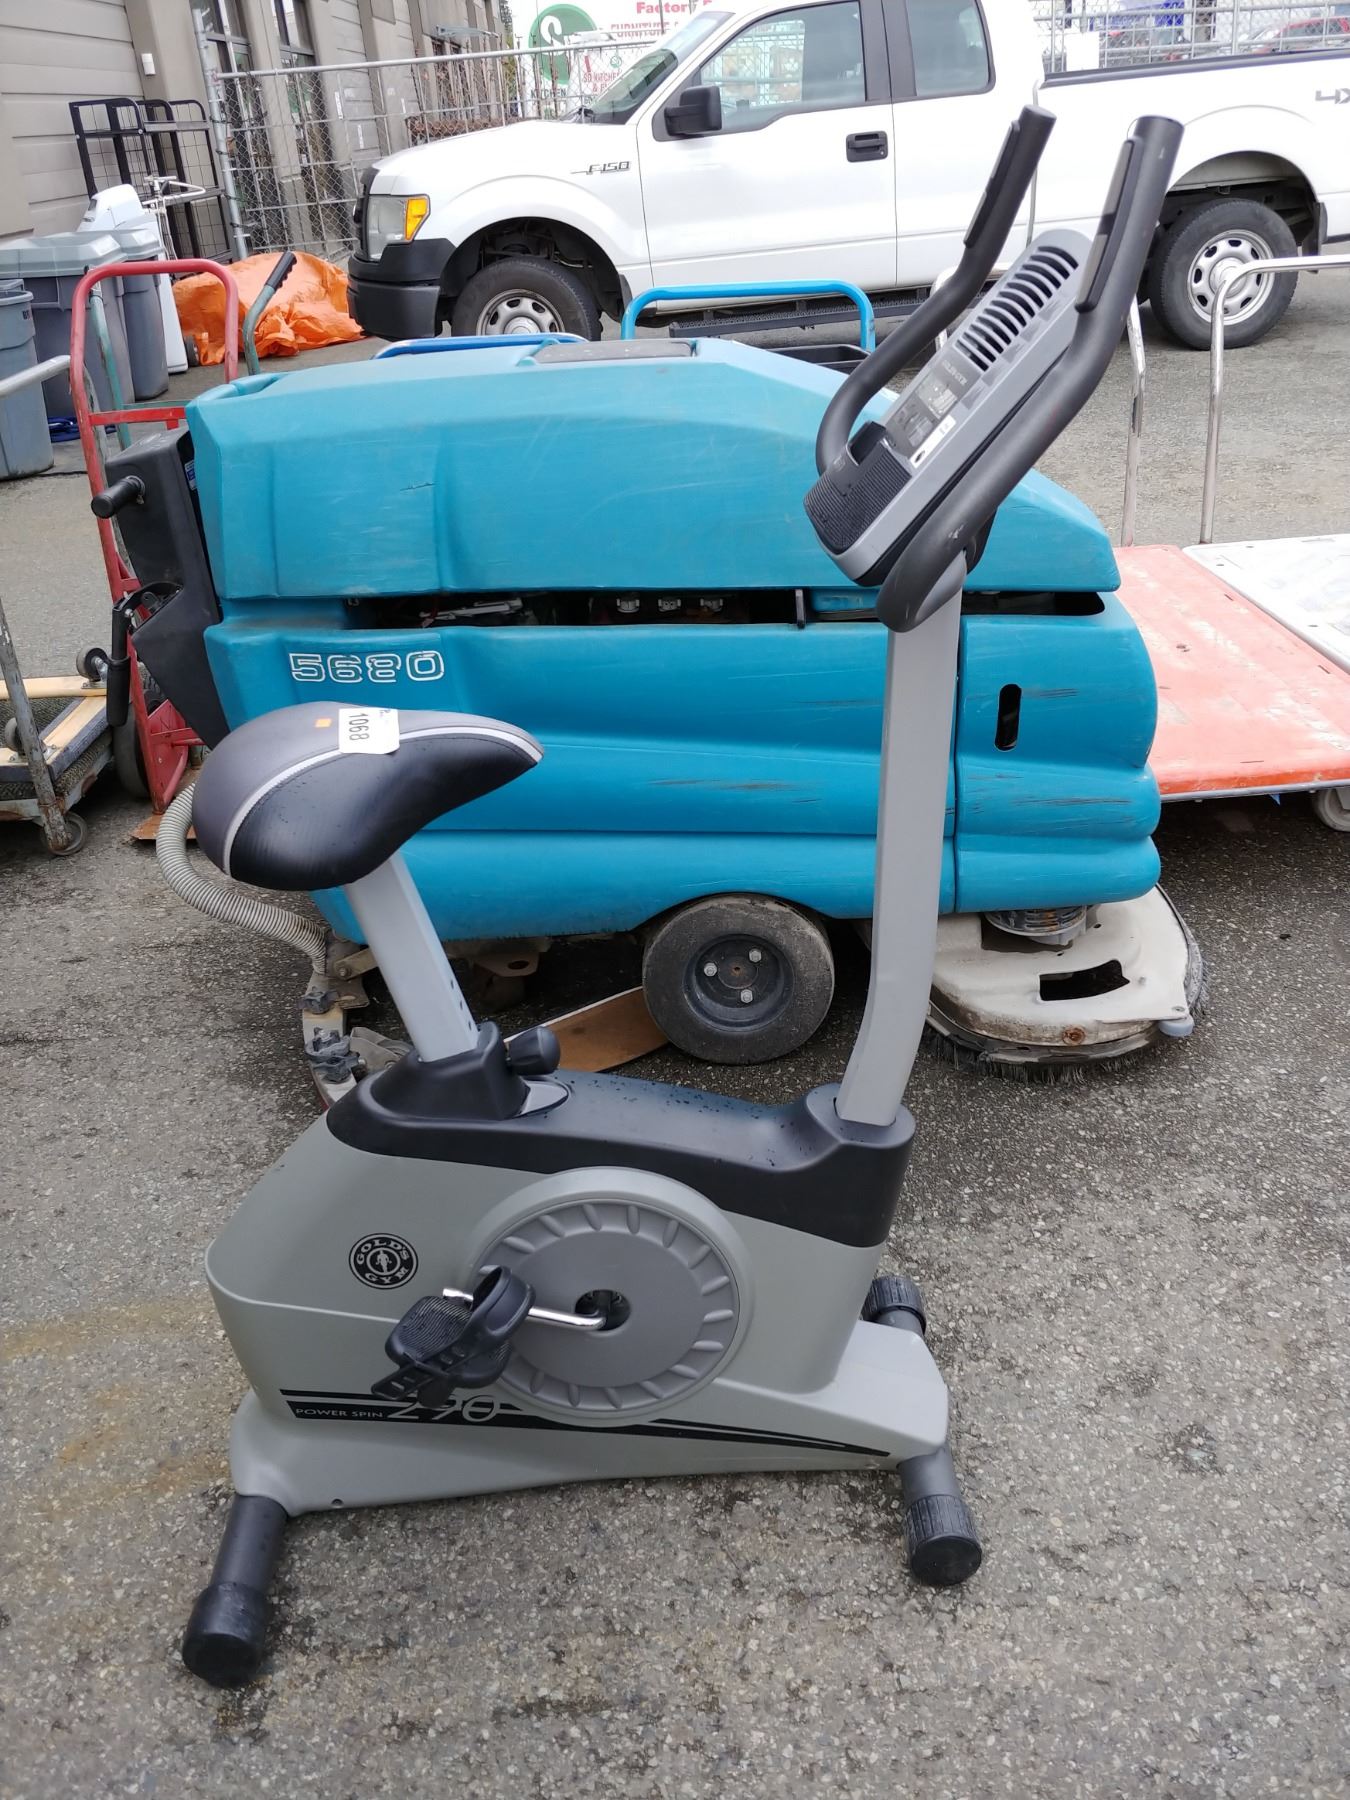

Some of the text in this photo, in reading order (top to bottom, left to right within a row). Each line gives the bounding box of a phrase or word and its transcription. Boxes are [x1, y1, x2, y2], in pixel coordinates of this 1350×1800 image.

[289, 650, 444, 683] 5680
[348, 712, 370, 741] 1068
[356, 1239, 410, 1265] GOLD'S
[365, 1266, 409, 1284] GYM
[296, 1408, 348, 1418] POWER
[351, 1410, 384, 1419] SPIN
